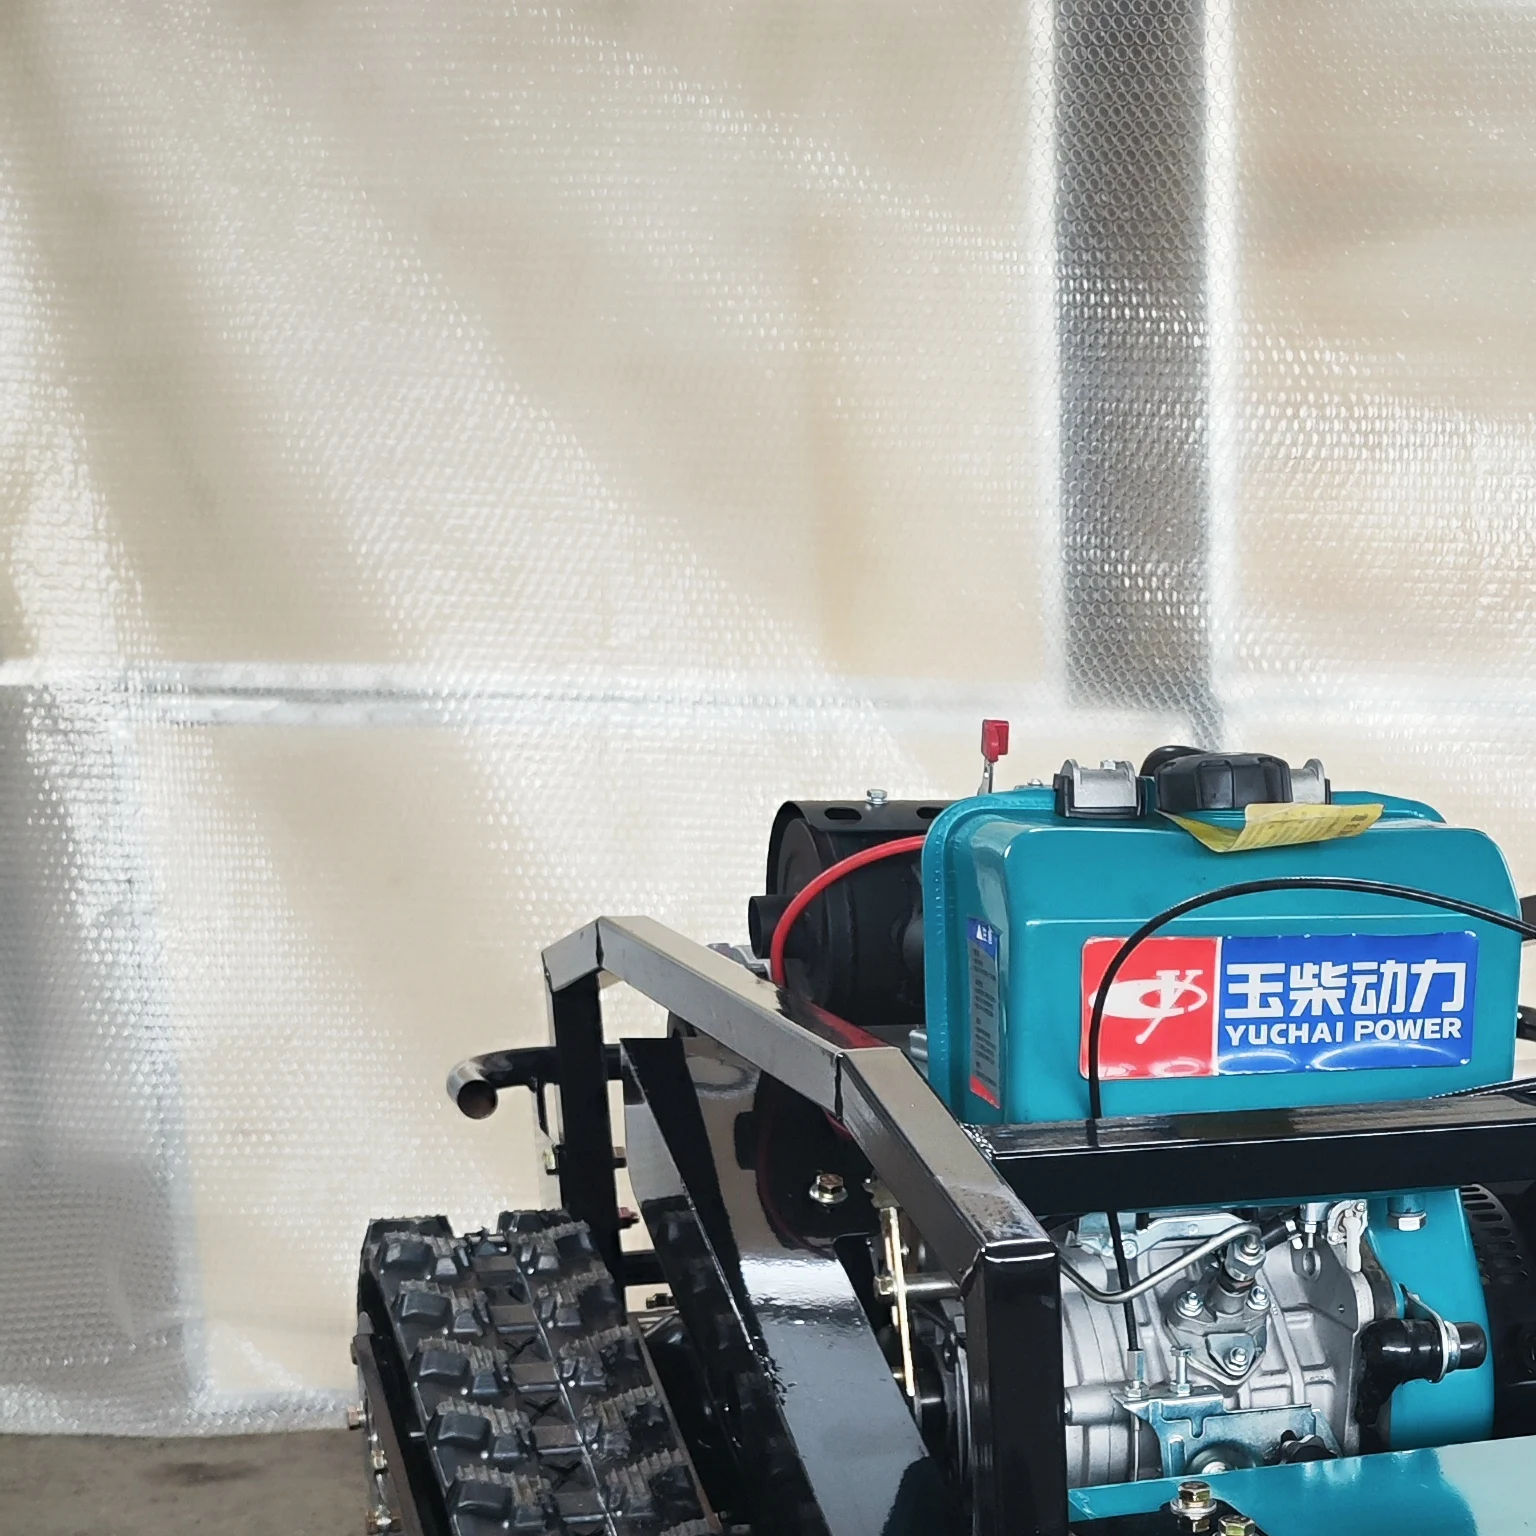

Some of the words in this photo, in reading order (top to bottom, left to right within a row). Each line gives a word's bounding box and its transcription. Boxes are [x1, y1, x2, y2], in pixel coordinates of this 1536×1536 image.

[1224, 959, 1467, 1019] 玉柴动力
[1225, 1020, 1344, 1047] YUCHAI
[1353, 1017, 1463, 1043] POWER
